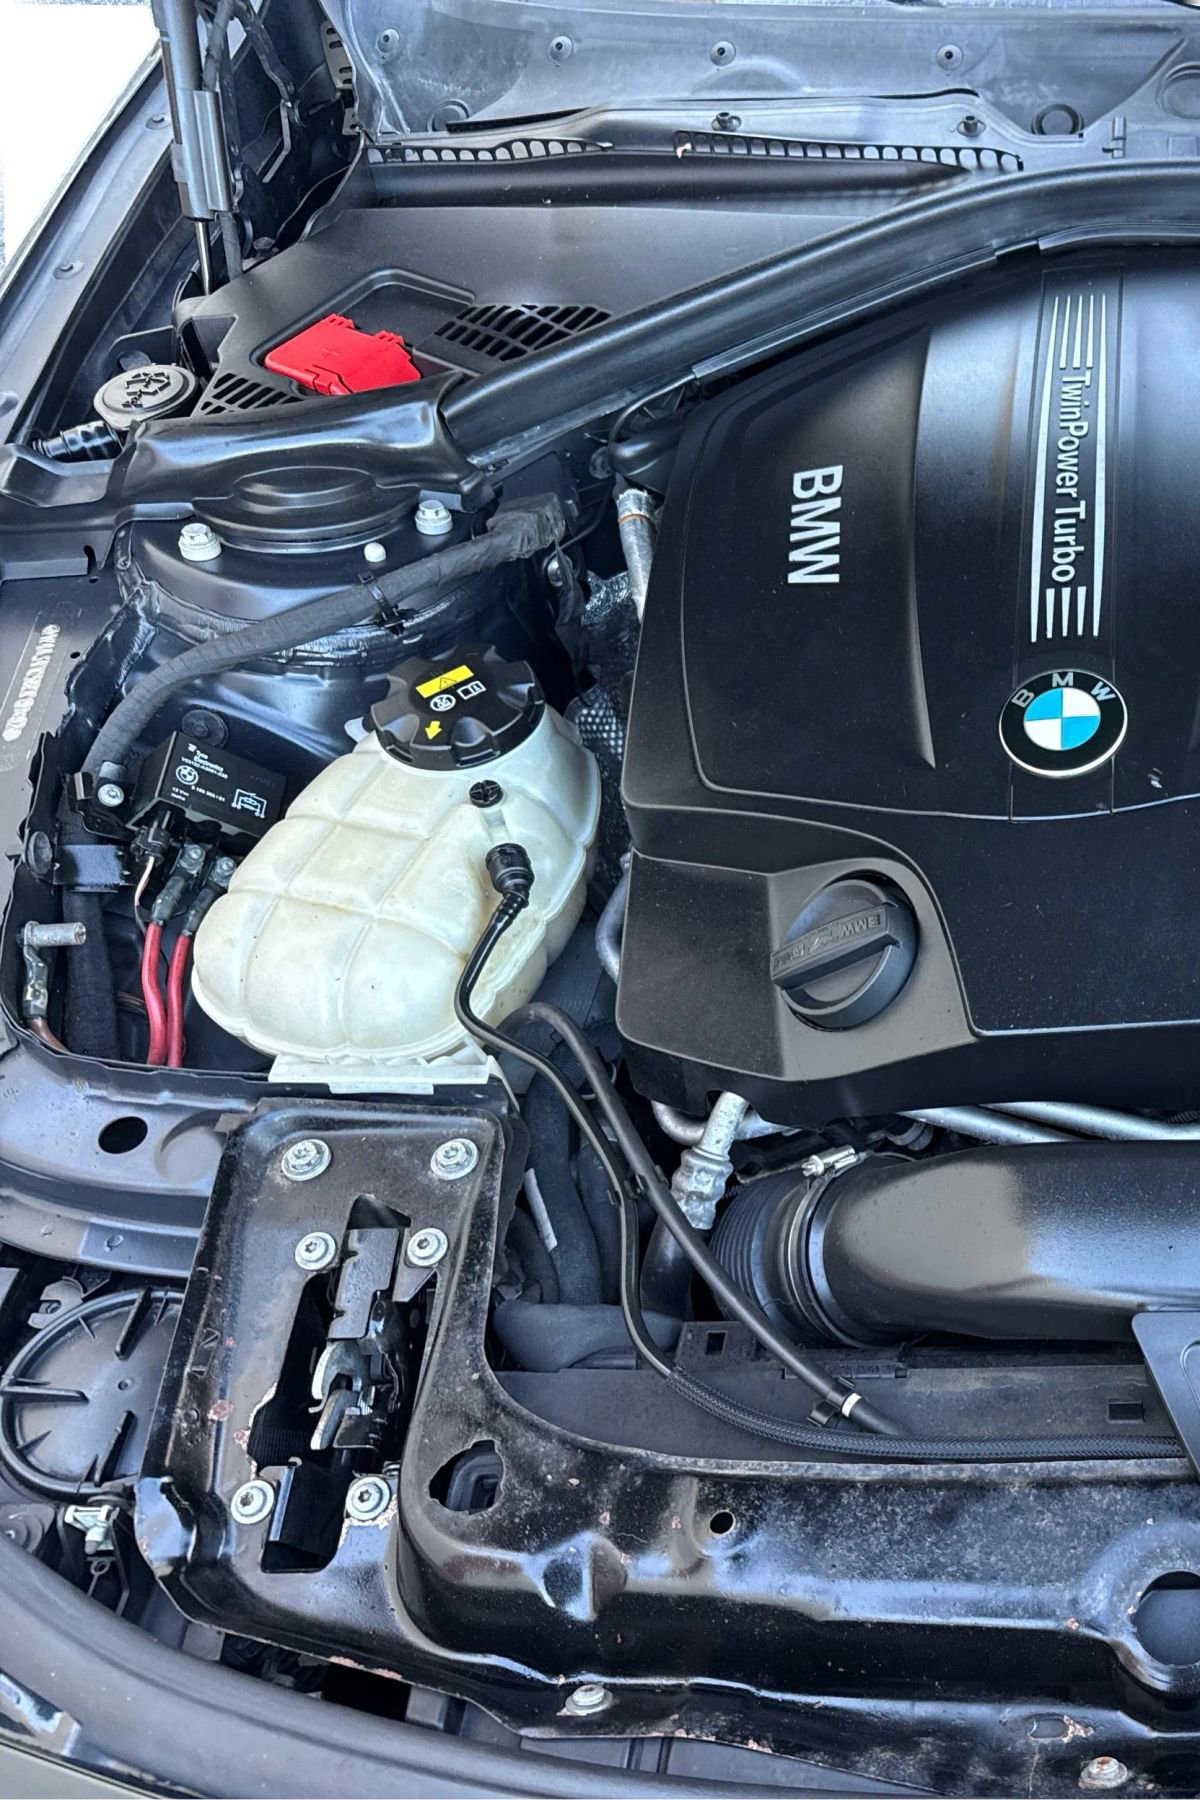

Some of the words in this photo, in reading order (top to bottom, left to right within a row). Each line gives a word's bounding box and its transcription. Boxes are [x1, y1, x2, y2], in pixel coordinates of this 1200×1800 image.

[1055, 370, 1092, 498] TwinPower
[787, 464, 844, 583] BMW
[1051, 500, 1086, 583] Turbo
[1011, 671, 1117, 708] BMW
[841, 914, 881, 939] BMW
